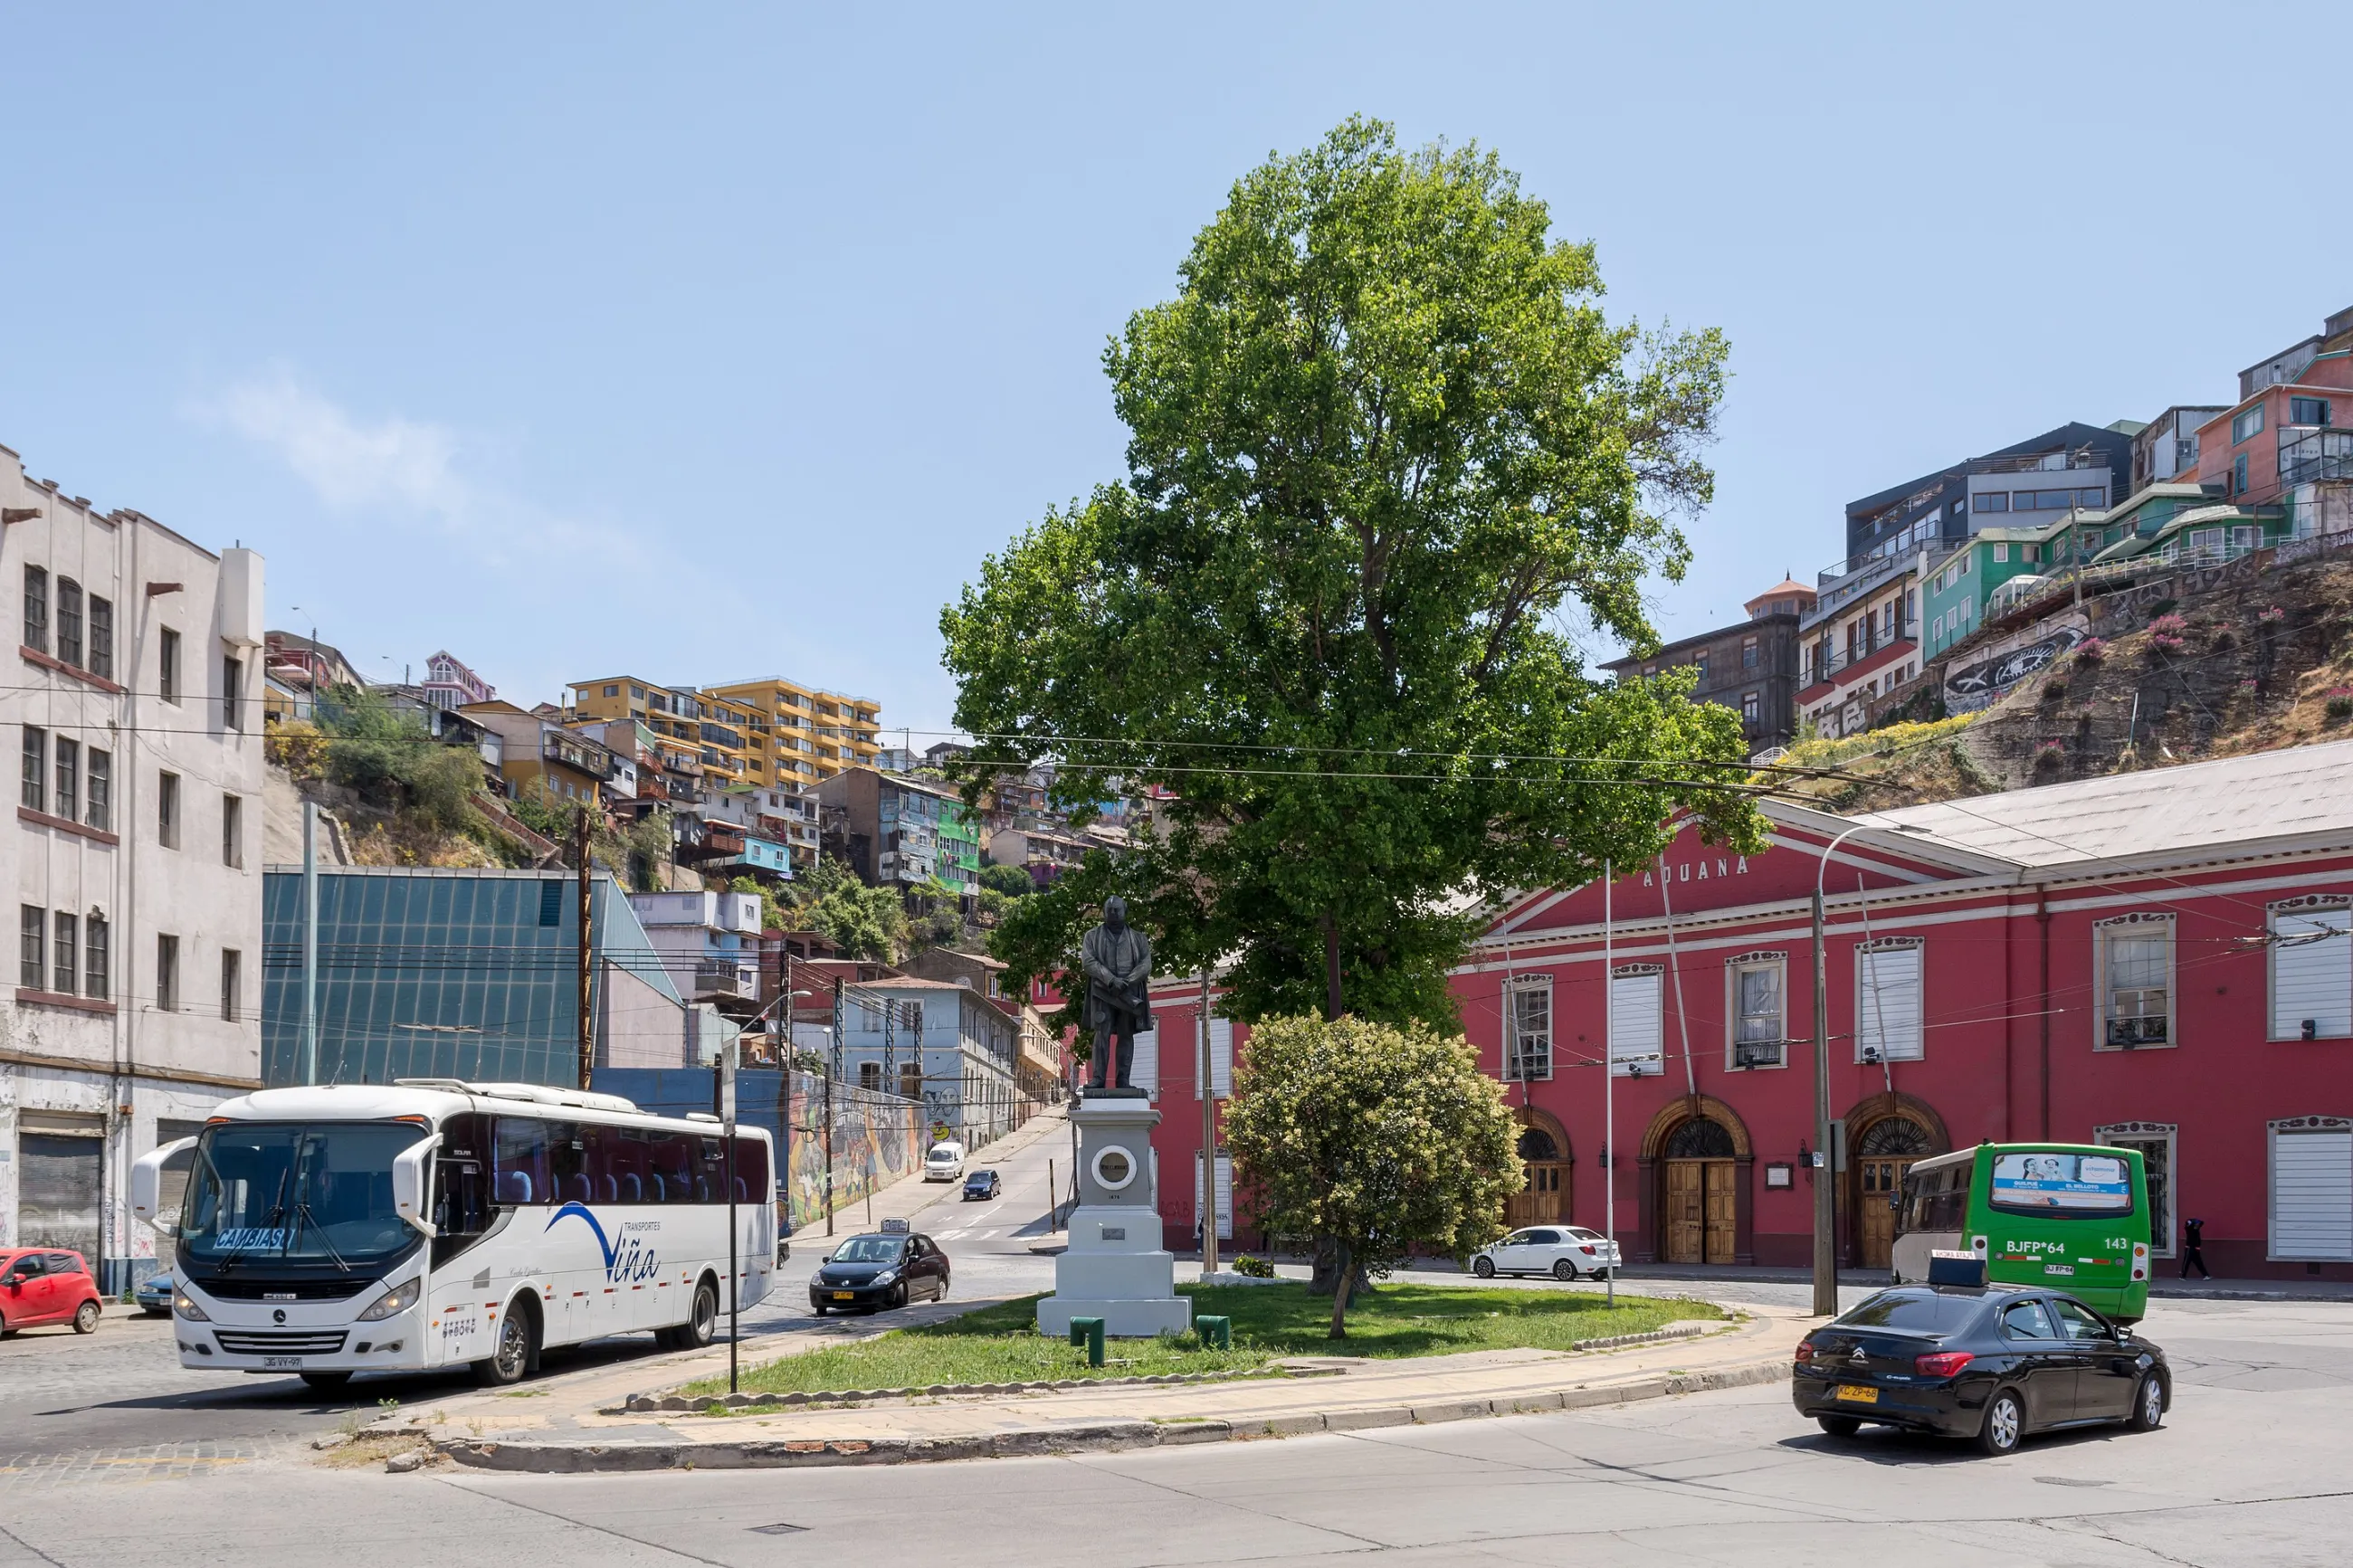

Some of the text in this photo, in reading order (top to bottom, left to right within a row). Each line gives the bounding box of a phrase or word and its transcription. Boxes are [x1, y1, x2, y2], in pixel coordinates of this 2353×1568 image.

[1643, 856, 1748, 887] ADUANA
[624, 1221, 661, 1231] TRANSPORTES
[543, 1201, 661, 1283] Viña
[2104, 1238, 2128, 1250] 143
